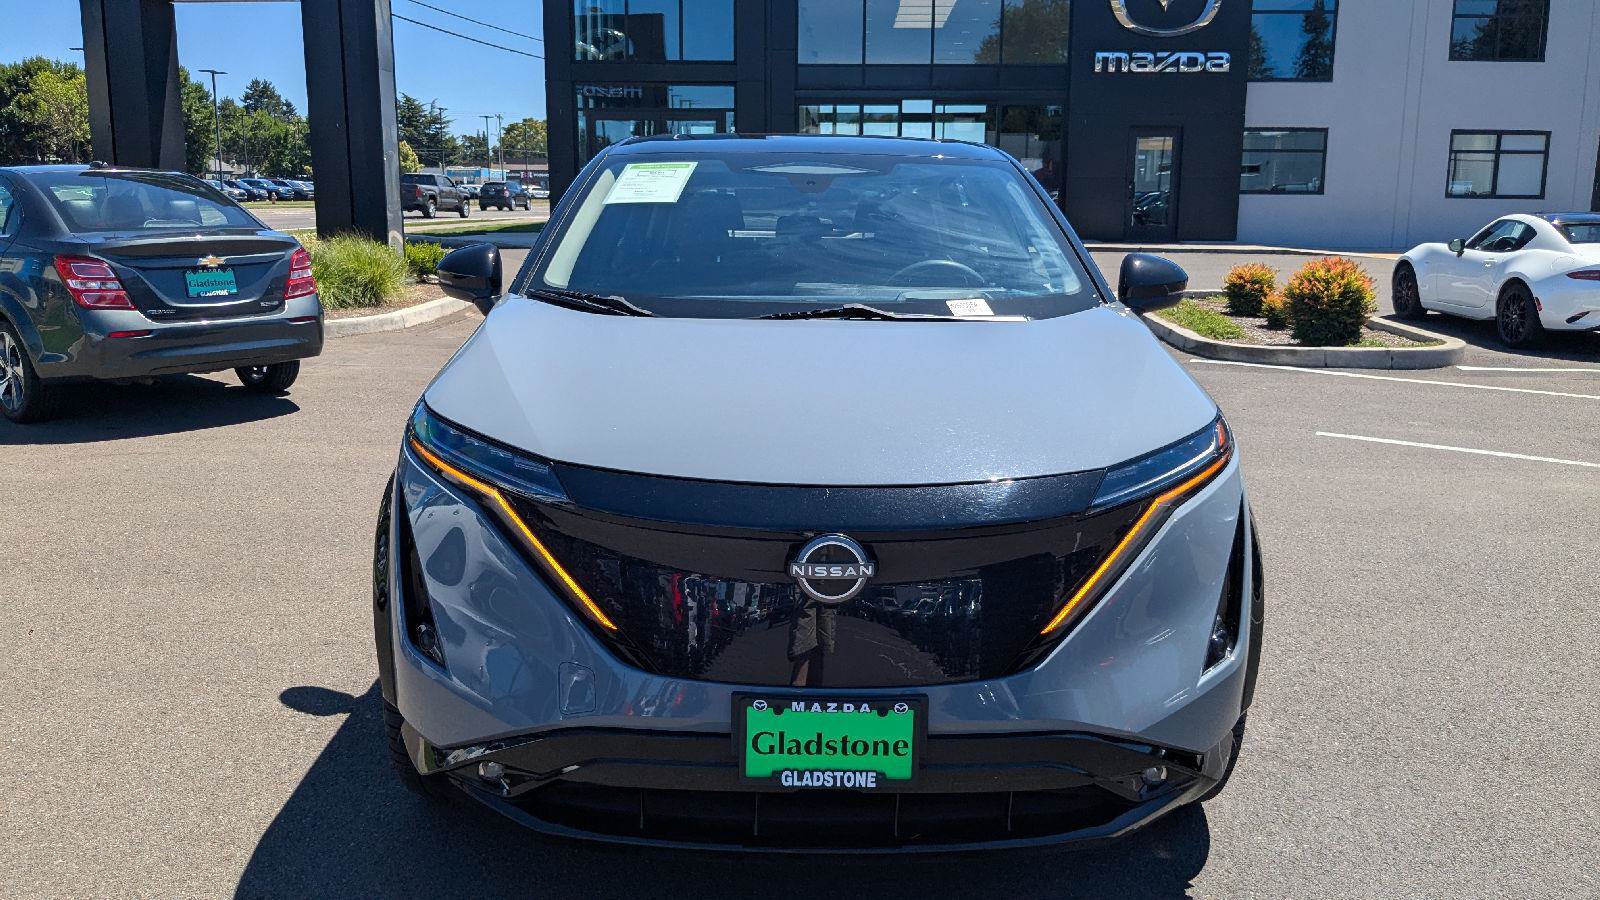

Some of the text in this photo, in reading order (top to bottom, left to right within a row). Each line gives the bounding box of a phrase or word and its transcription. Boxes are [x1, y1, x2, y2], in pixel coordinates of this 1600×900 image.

[188, 279, 235, 288] Gladstone
[792, 564, 873, 577] NISSAN
[791, 701, 871, 713] MAZDA
[751, 731, 909, 757] Gladstone
[781, 770, 877, 788] GLADSTONE
